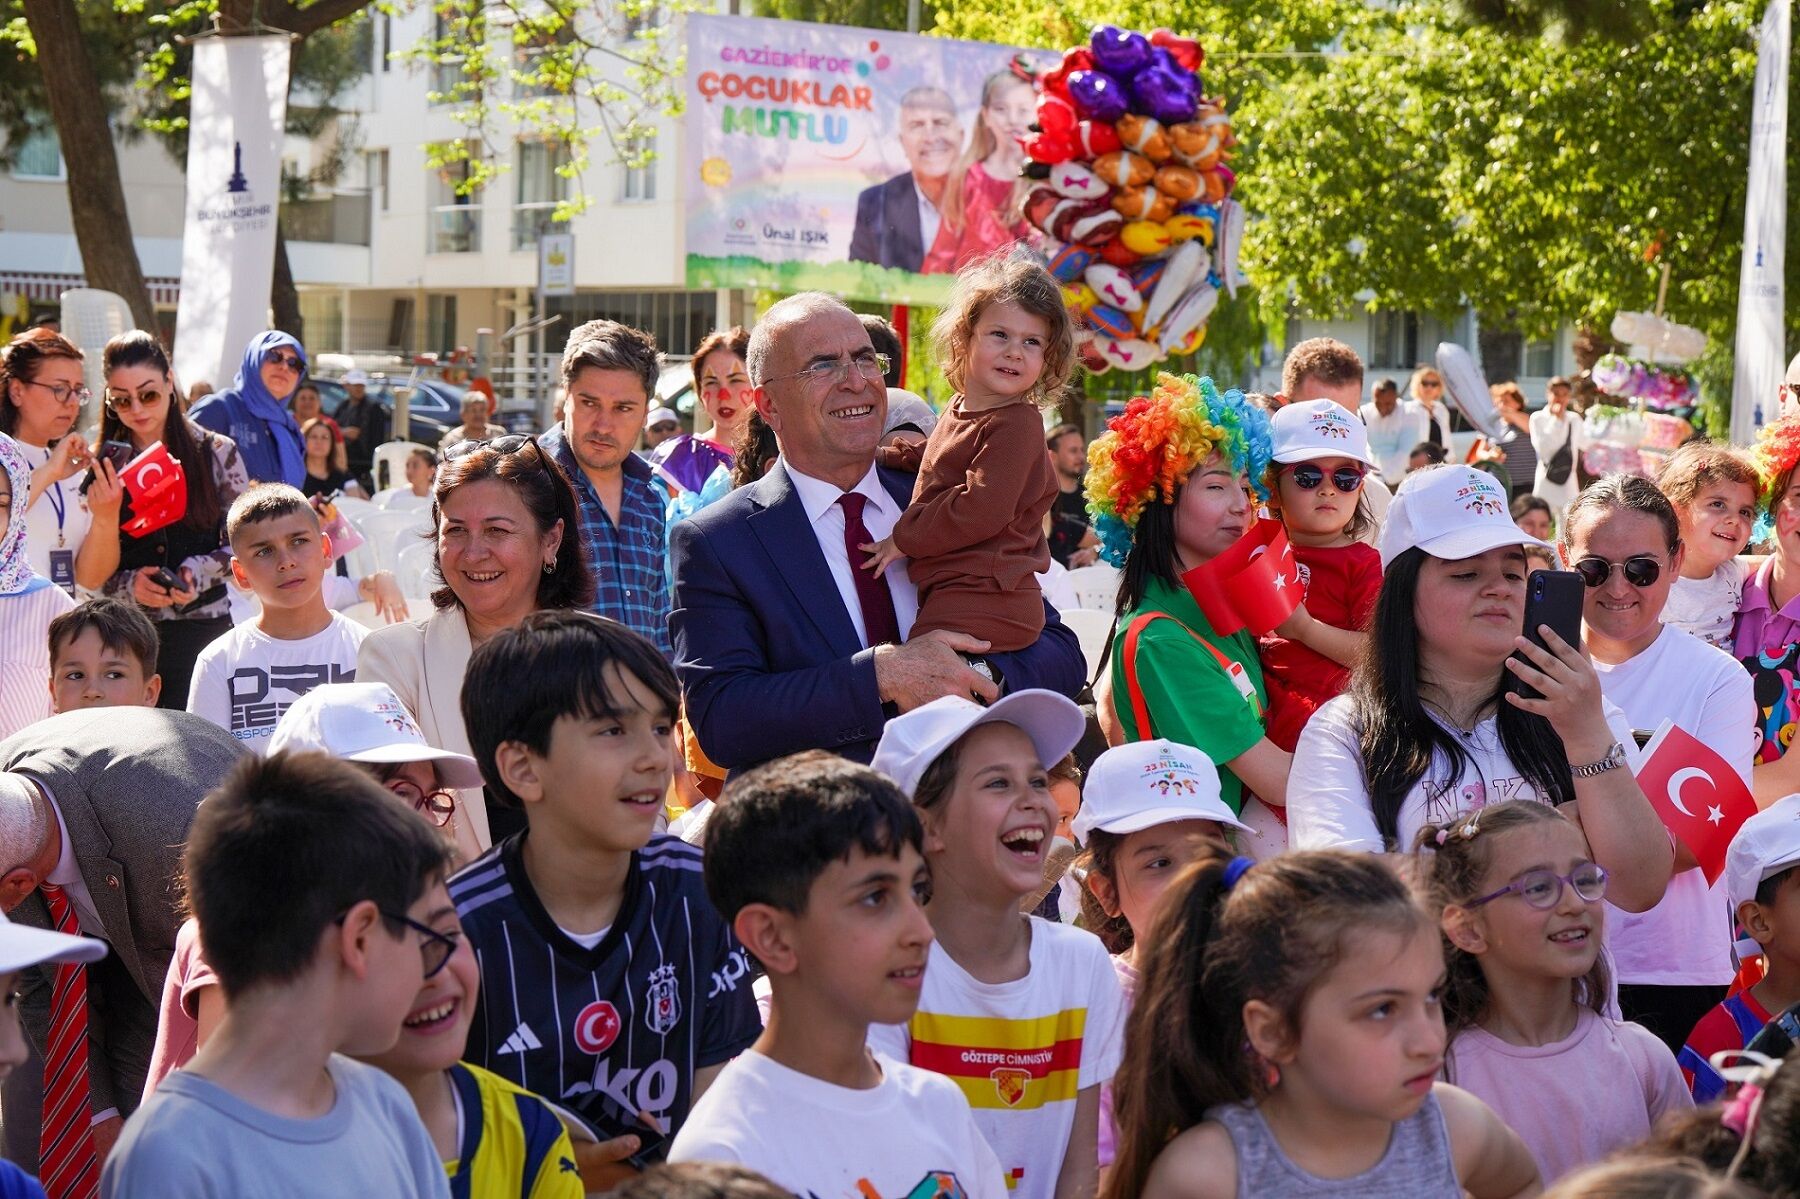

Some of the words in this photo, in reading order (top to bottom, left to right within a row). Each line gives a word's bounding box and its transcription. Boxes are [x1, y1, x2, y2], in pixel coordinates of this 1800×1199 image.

[697, 70, 873, 111] ÇOCUKLAR
[722, 105, 848, 144] MUTLU
[1457, 487, 1469, 497] 23
[1144, 763, 1157, 772] 23
[1160, 760, 1192, 770] NİSAN
[961, 1050, 1006, 1064] GÖZTEPE
